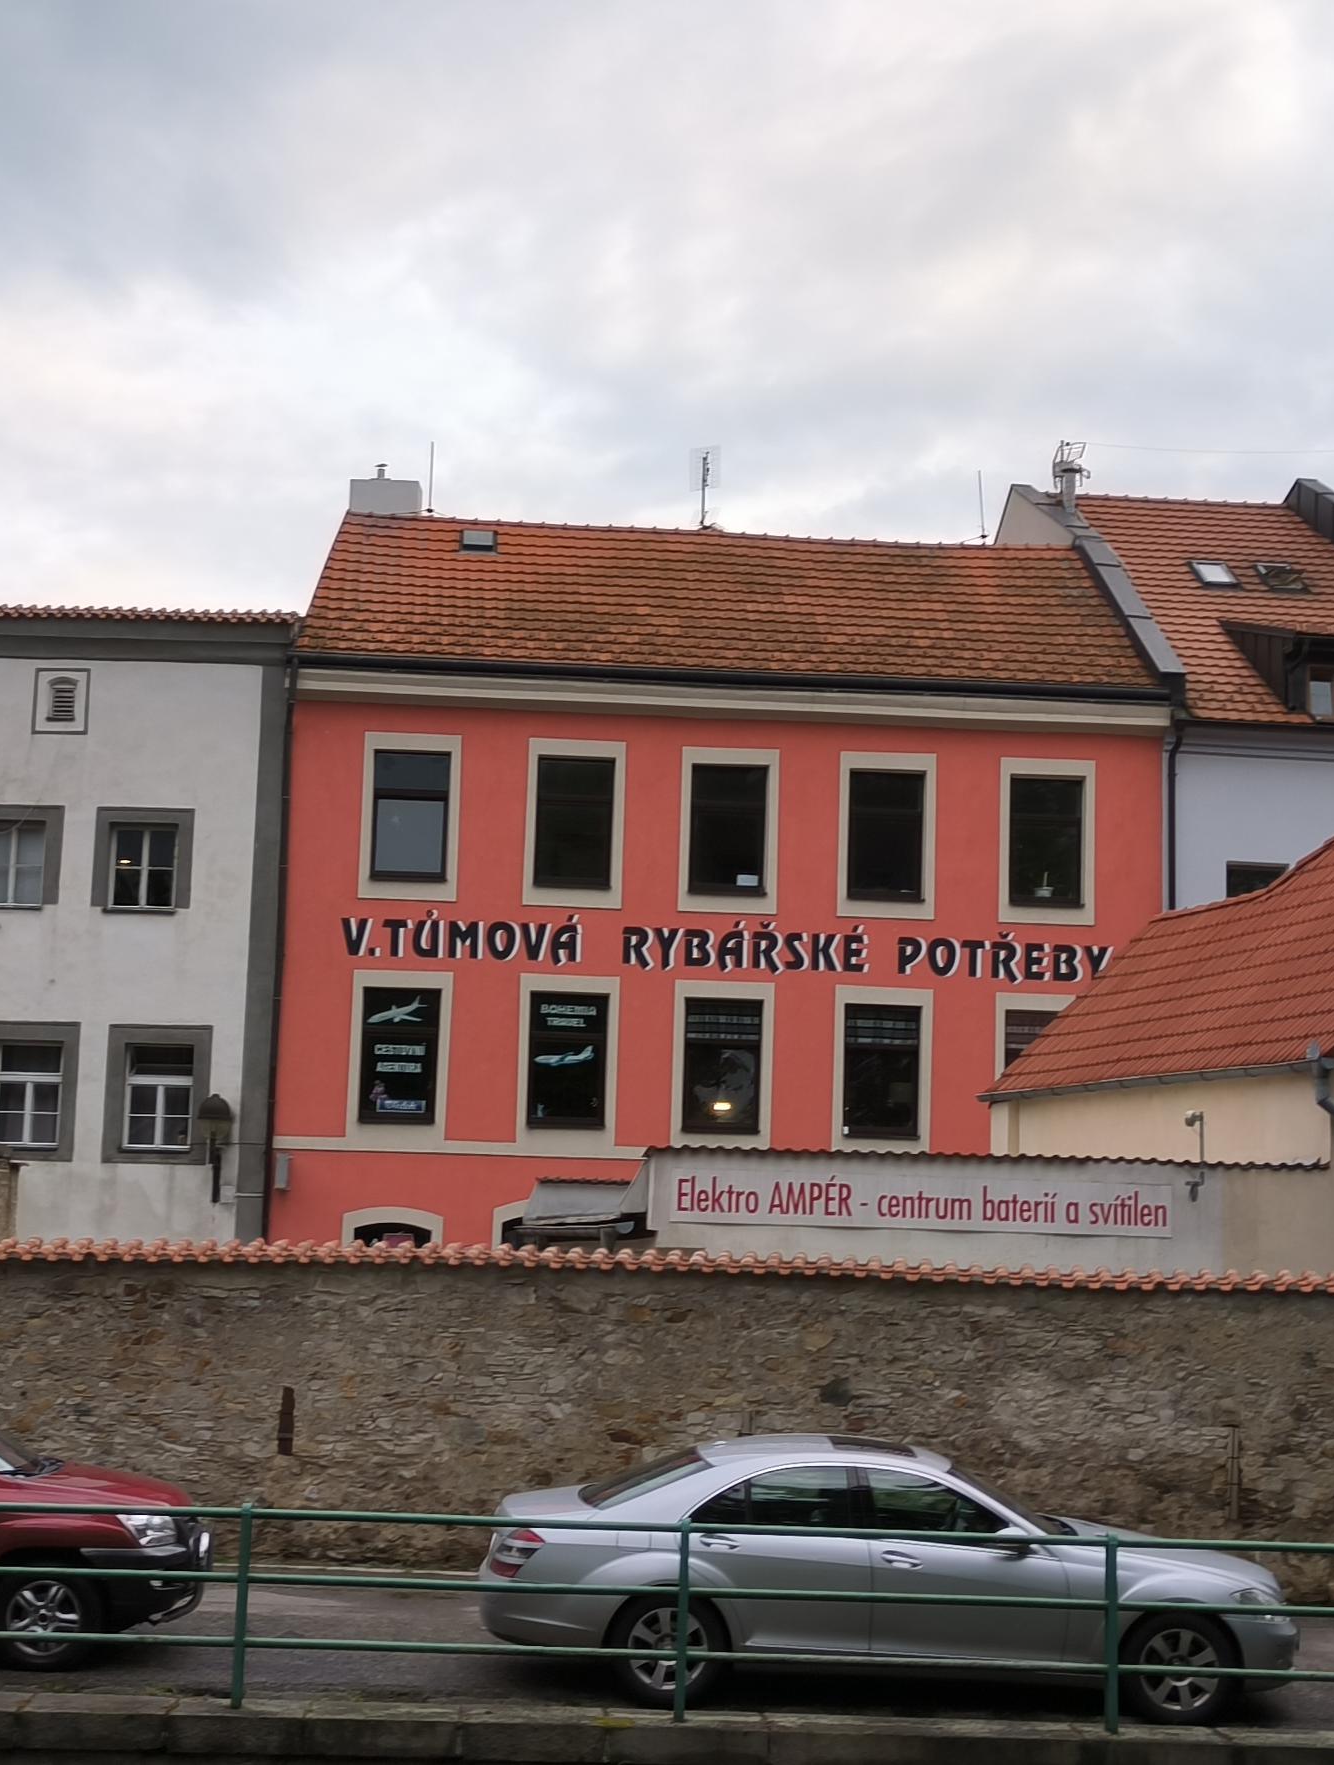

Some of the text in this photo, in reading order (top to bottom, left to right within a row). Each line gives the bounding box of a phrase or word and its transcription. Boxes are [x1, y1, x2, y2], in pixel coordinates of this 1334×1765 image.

[341, 909, 1115, 985] V.TŮMOVÁ RYBÁŘSKÉ POTŘEBY
[676, 1176, 760, 1214] Elektro
[767, 1175, 853, 1217] AMPÉR
[877, 1190, 972, 1221] centrum
[982, 1185, 1057, 1224] baterií
[1065, 1201, 1080, 1225] a
[1088, 1190, 1169, 1228] svítilen
